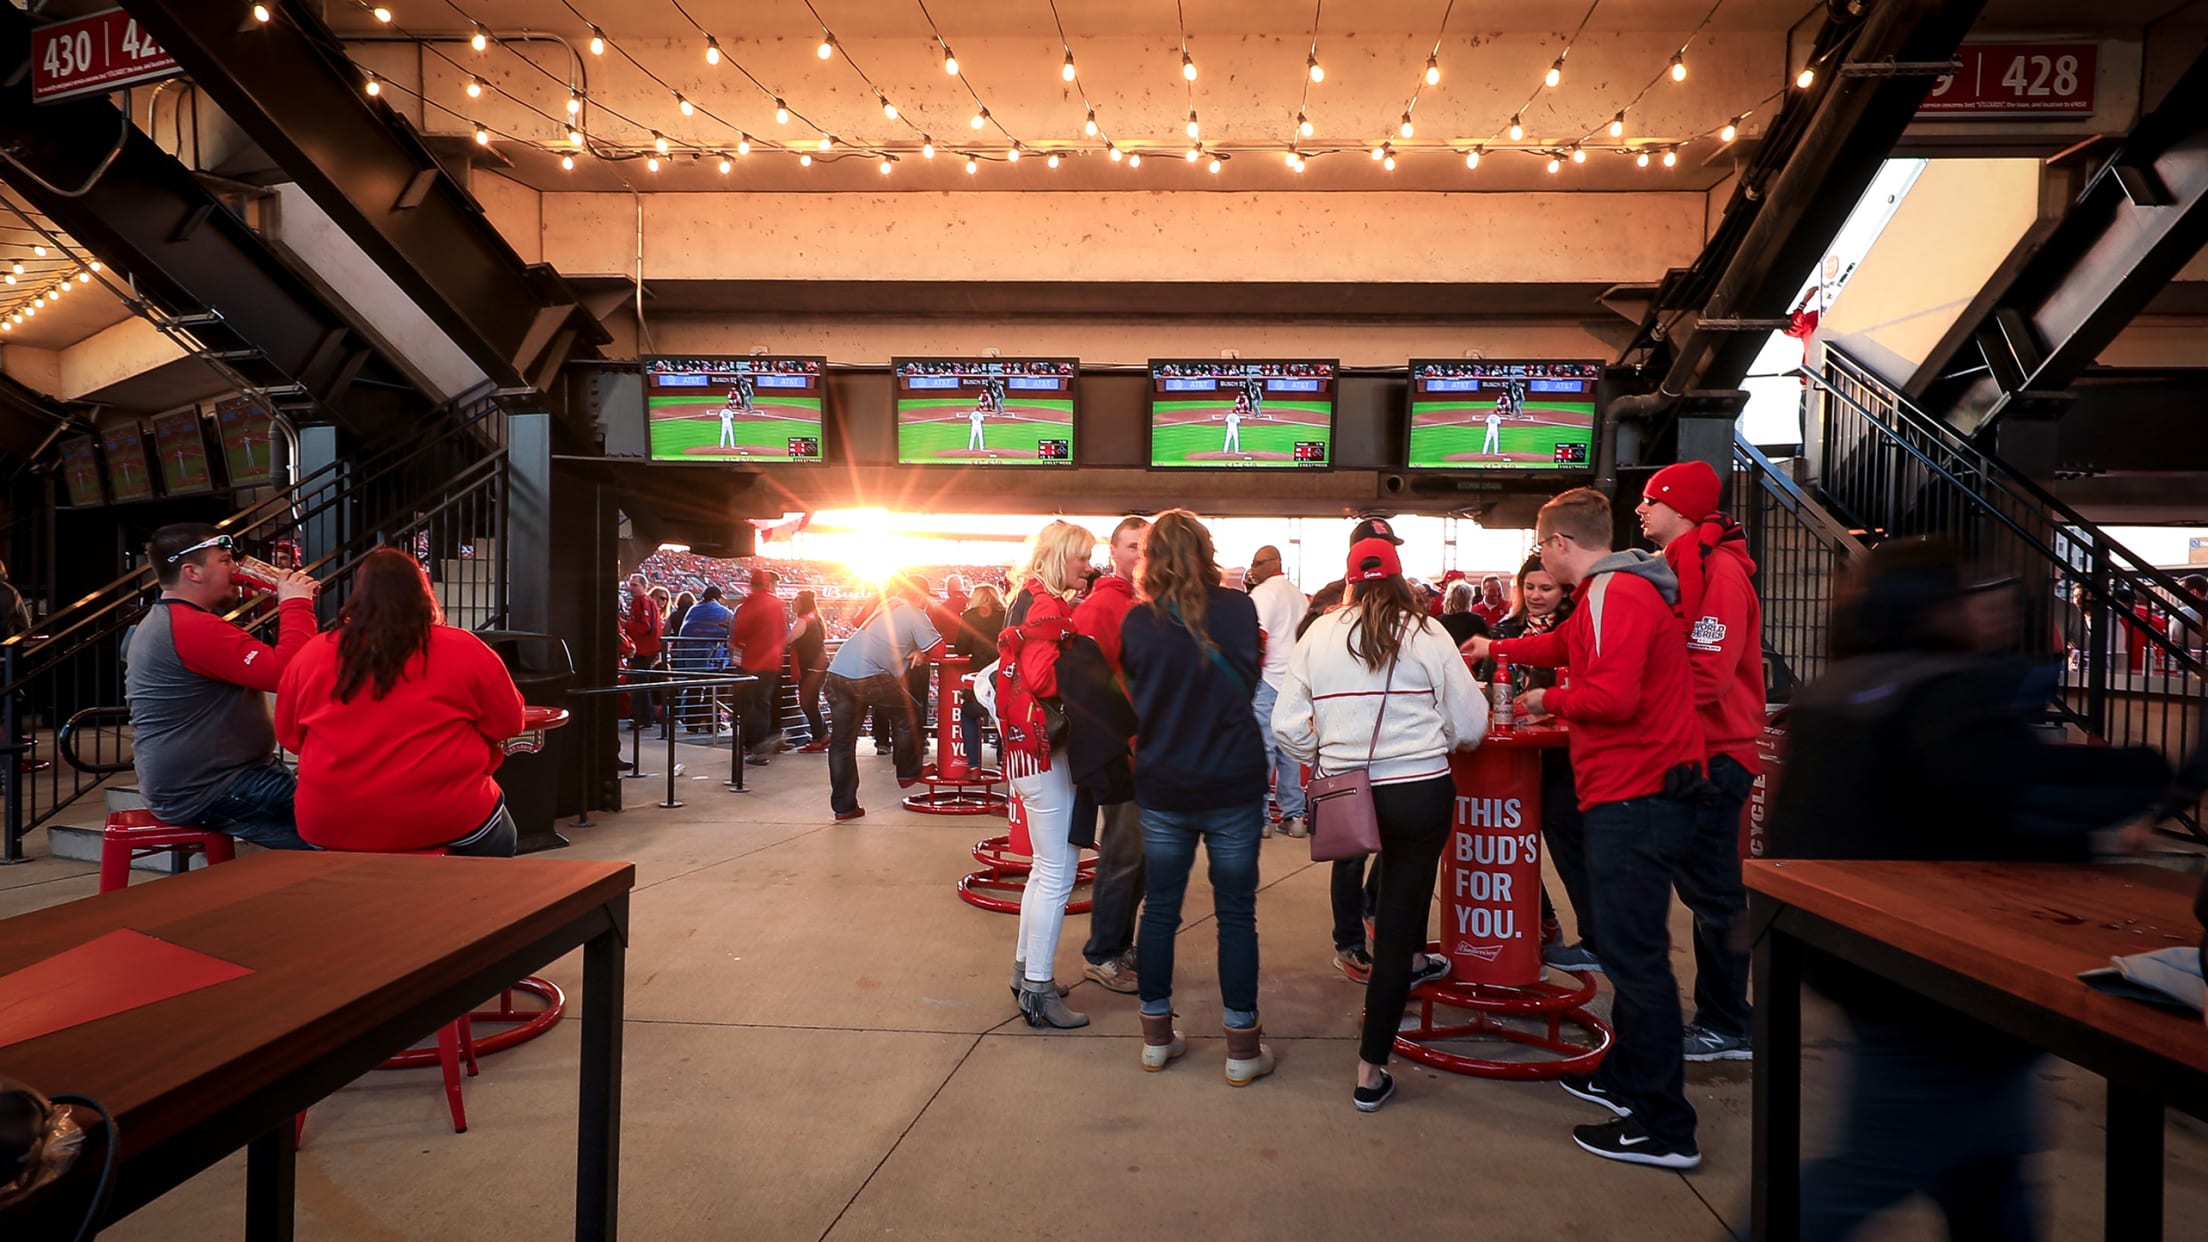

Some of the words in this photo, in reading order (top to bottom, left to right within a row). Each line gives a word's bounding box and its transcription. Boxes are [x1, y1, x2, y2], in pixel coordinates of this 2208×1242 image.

[43, 30, 92, 79] 430
[122, 18, 166, 60] 42
[2001, 54, 2079, 97] 428
[1455, 796, 1521, 828] THIS
[1750, 773, 1766, 858] CYCLE
[1456, 868, 1512, 901] FOR
[1455, 904, 1522, 938] YOU.
